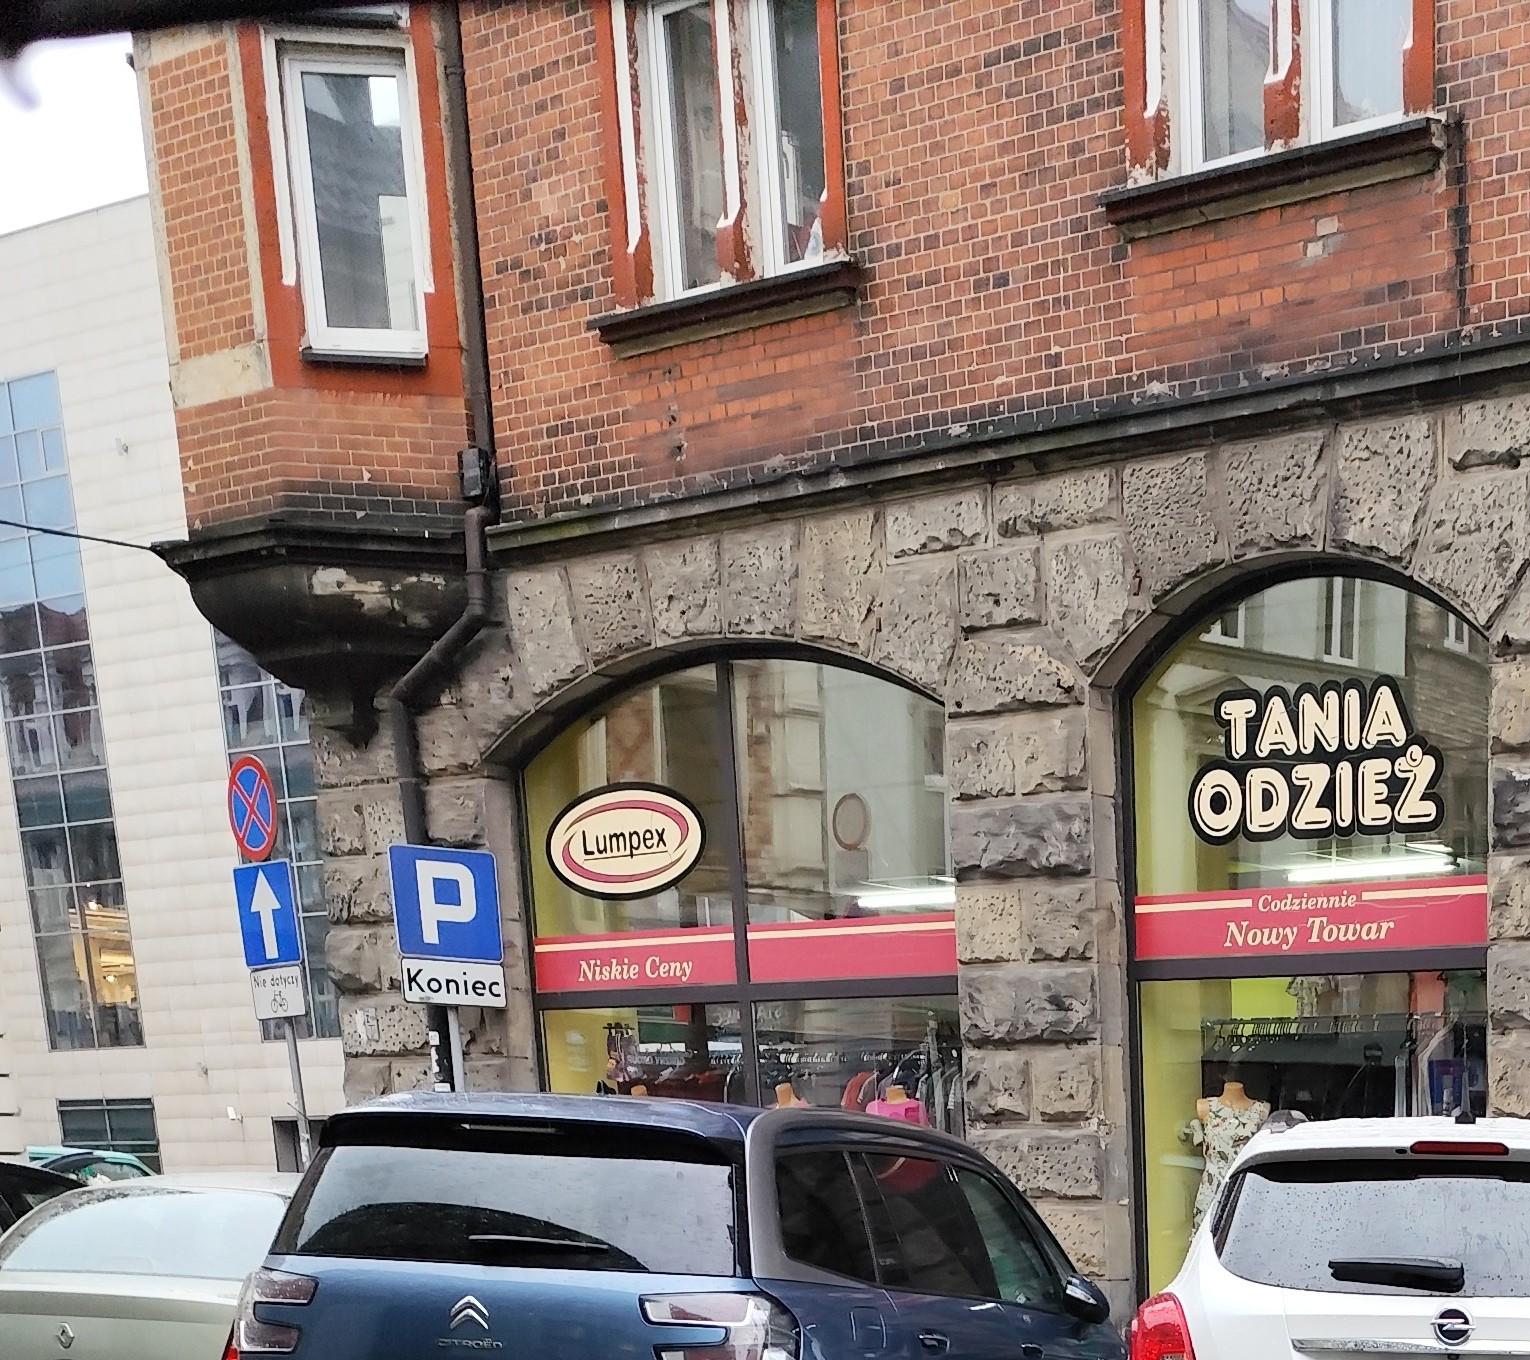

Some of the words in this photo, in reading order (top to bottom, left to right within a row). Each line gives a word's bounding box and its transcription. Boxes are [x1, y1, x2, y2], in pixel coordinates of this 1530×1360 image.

[1220, 684, 1407, 760] TANIA
[1193, 743, 1438, 838] ODZIEŻ
[581, 827, 667, 859] Lumpex
[415, 859, 477, 945] P
[1258, 890, 1357, 912] Codziennie
[1223, 920, 1298, 950] Nowy
[1307, 916, 1395, 943] Towar
[253, 975, 267, 988] Nie
[270, 974, 299, 989] dotyczy
[406, 967, 502, 998] Koniec
[578, 957, 639, 982] Niskie
[645, 955, 693, 981] Ceny
